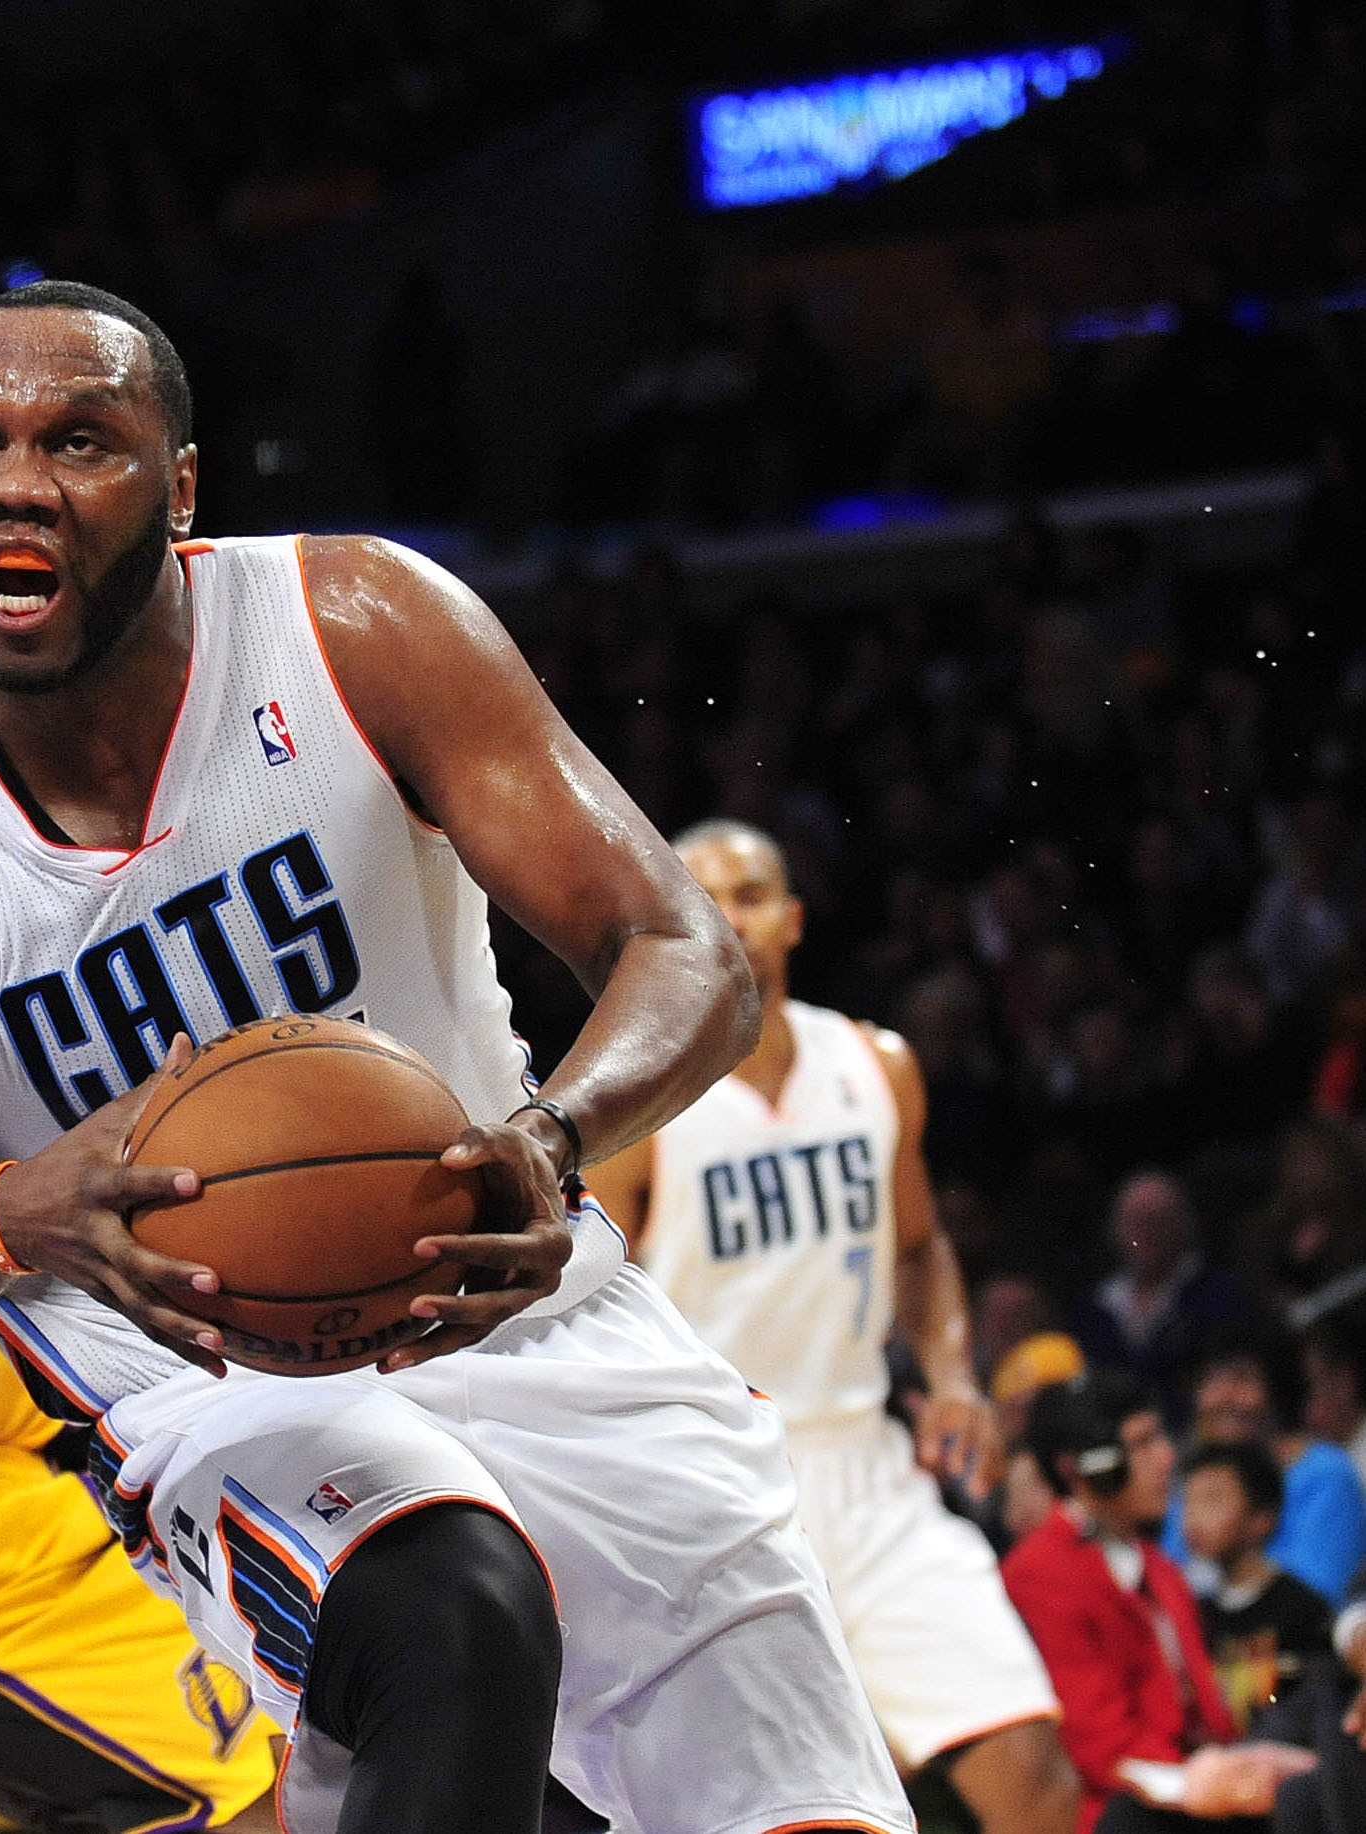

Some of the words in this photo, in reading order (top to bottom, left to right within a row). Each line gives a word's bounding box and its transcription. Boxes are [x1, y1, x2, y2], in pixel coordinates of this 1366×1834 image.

[268, 749, 290, 765] NBA
[701, 1135, 877, 1260] CATS
[844, 1246, 873, 1341] 7
